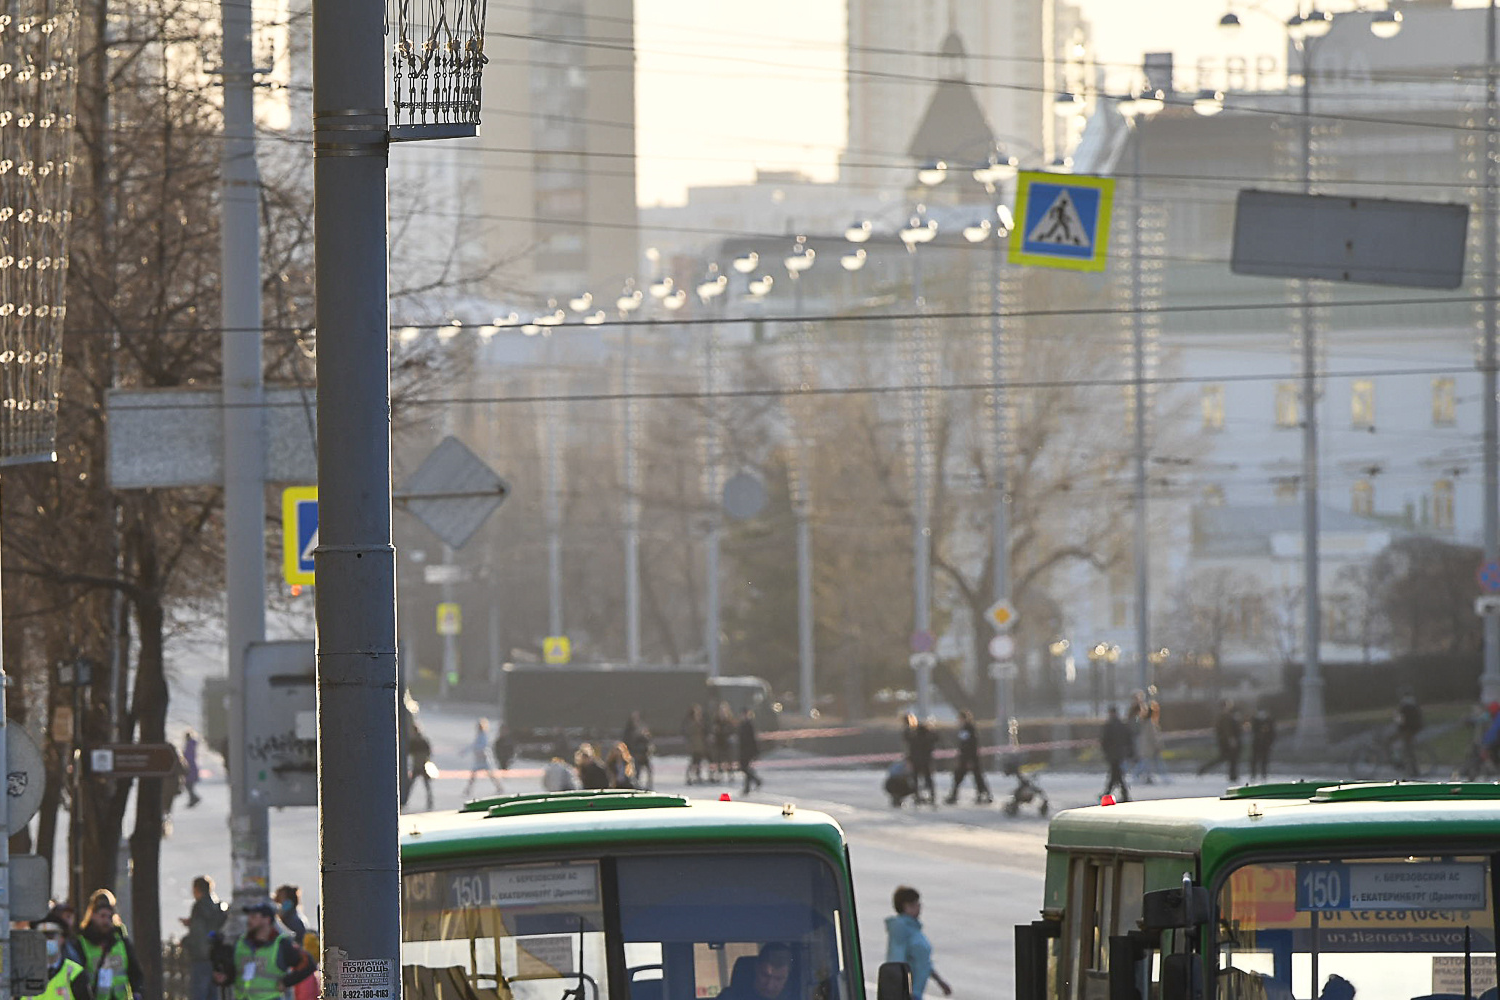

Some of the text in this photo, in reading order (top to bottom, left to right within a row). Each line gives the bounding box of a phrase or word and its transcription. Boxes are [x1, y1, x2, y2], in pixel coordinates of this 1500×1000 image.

[1384, 871, 1445, 882] БЕРЕЗОВСКИЙ
[452, 875, 483, 906] 150
[1303, 870, 1341, 907] 150
[1361, 893, 1427, 902] ЕКАТЕРИНБУРГ
